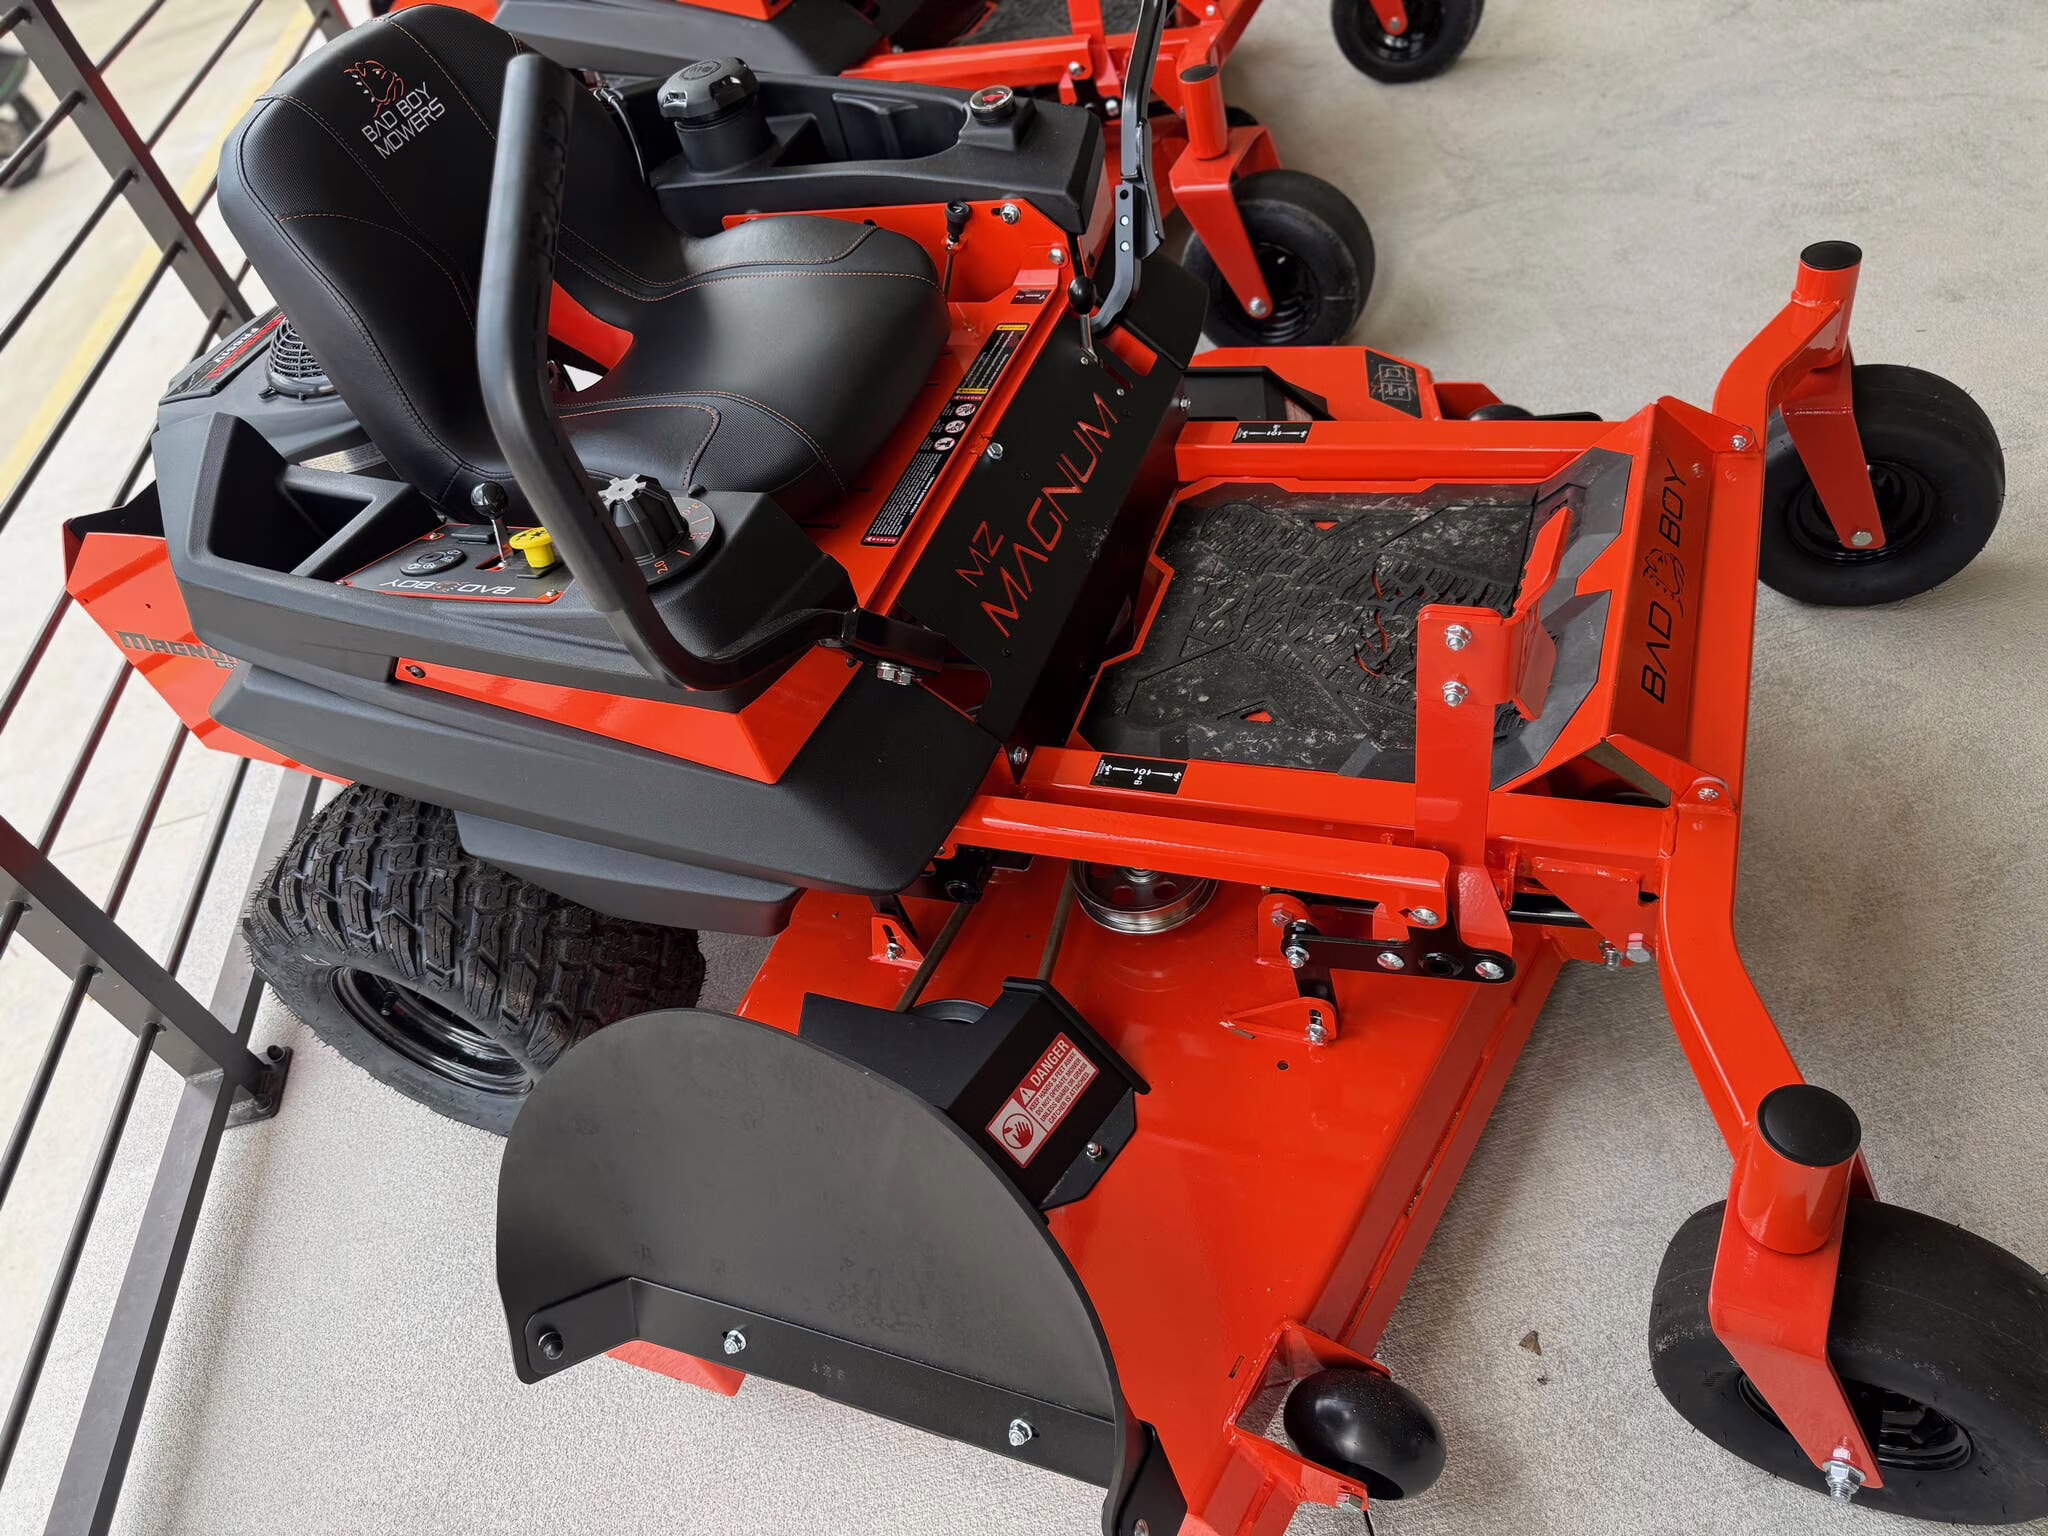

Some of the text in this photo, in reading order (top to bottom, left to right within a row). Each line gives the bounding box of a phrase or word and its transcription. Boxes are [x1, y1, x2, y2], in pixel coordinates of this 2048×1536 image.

[362, 81, 430, 142] BAD BOY
[374, 97, 446, 159] MOWERS
[980, 391, 1118, 638] MAGNUM
[956, 520, 1004, 588] MZ
[1641, 457, 1686, 704] BAD BOY
[379, 578, 516, 595] BAD BOY
[1029, 1039, 1070, 1087] DANGER
[1029, 1097, 1041, 1111] KEEP
[1038, 1081, 1053, 1099] HANDS
[1054, 1065, 1065, 1077] FEET
[1040, 1101, 1057, 1121] UNLESS
[1054, 1085, 1069, 1103] GUARD
[1073, 1062, 1087, 1080] GRASS
[1041, 1096, 1051, 1108] NOT
[1049, 1075, 1067, 1098] OPERATE
[1065, 1057, 1081, 1077] MOWER
[1048, 1100, 1067, 1124] CATCHER
